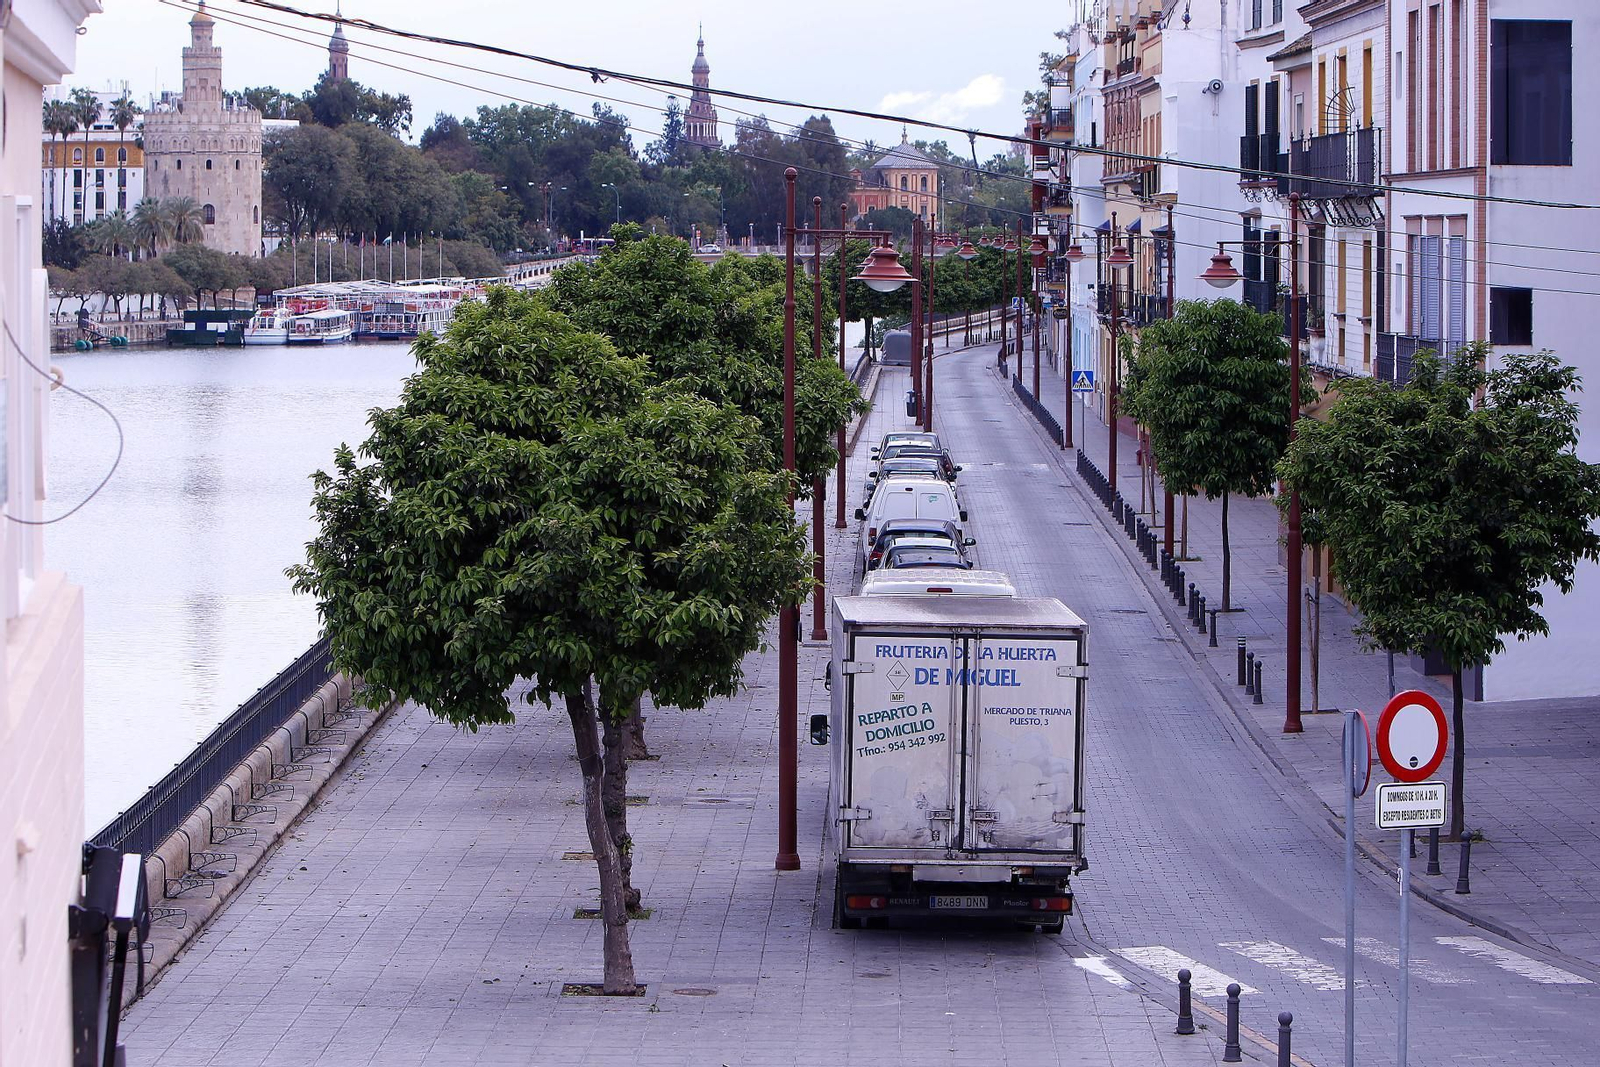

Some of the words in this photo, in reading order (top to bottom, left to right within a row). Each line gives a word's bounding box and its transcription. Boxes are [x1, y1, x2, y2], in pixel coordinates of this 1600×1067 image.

[875, 645, 948, 659] FRUTERIA
[977, 646, 993, 660] LA
[998, 647, 1057, 661] HUERTA
[914, 667, 940, 685] DE
[945, 668, 1021, 687] MIGUEL
[858, 705, 918, 727] REPARTO
[921, 702, 933, 715] A
[984, 707, 1025, 715] MERCADO
[1039, 708, 1072, 716] TRIANA
[1044, 718, 1049, 726] 3
[865, 719, 935, 742] DOMICILIO
[888, 740, 906, 753] 954
[908, 736, 926, 748] 342
[928, 732, 946, 745] 992
[1387, 791, 1408, 802] DOMINGOS
[1408, 791, 1414, 801] DE
[1383, 811, 1400, 821] EXCEPTO
[937, 897, 961, 907] 8489
[966, 897, 986, 907] DNN
